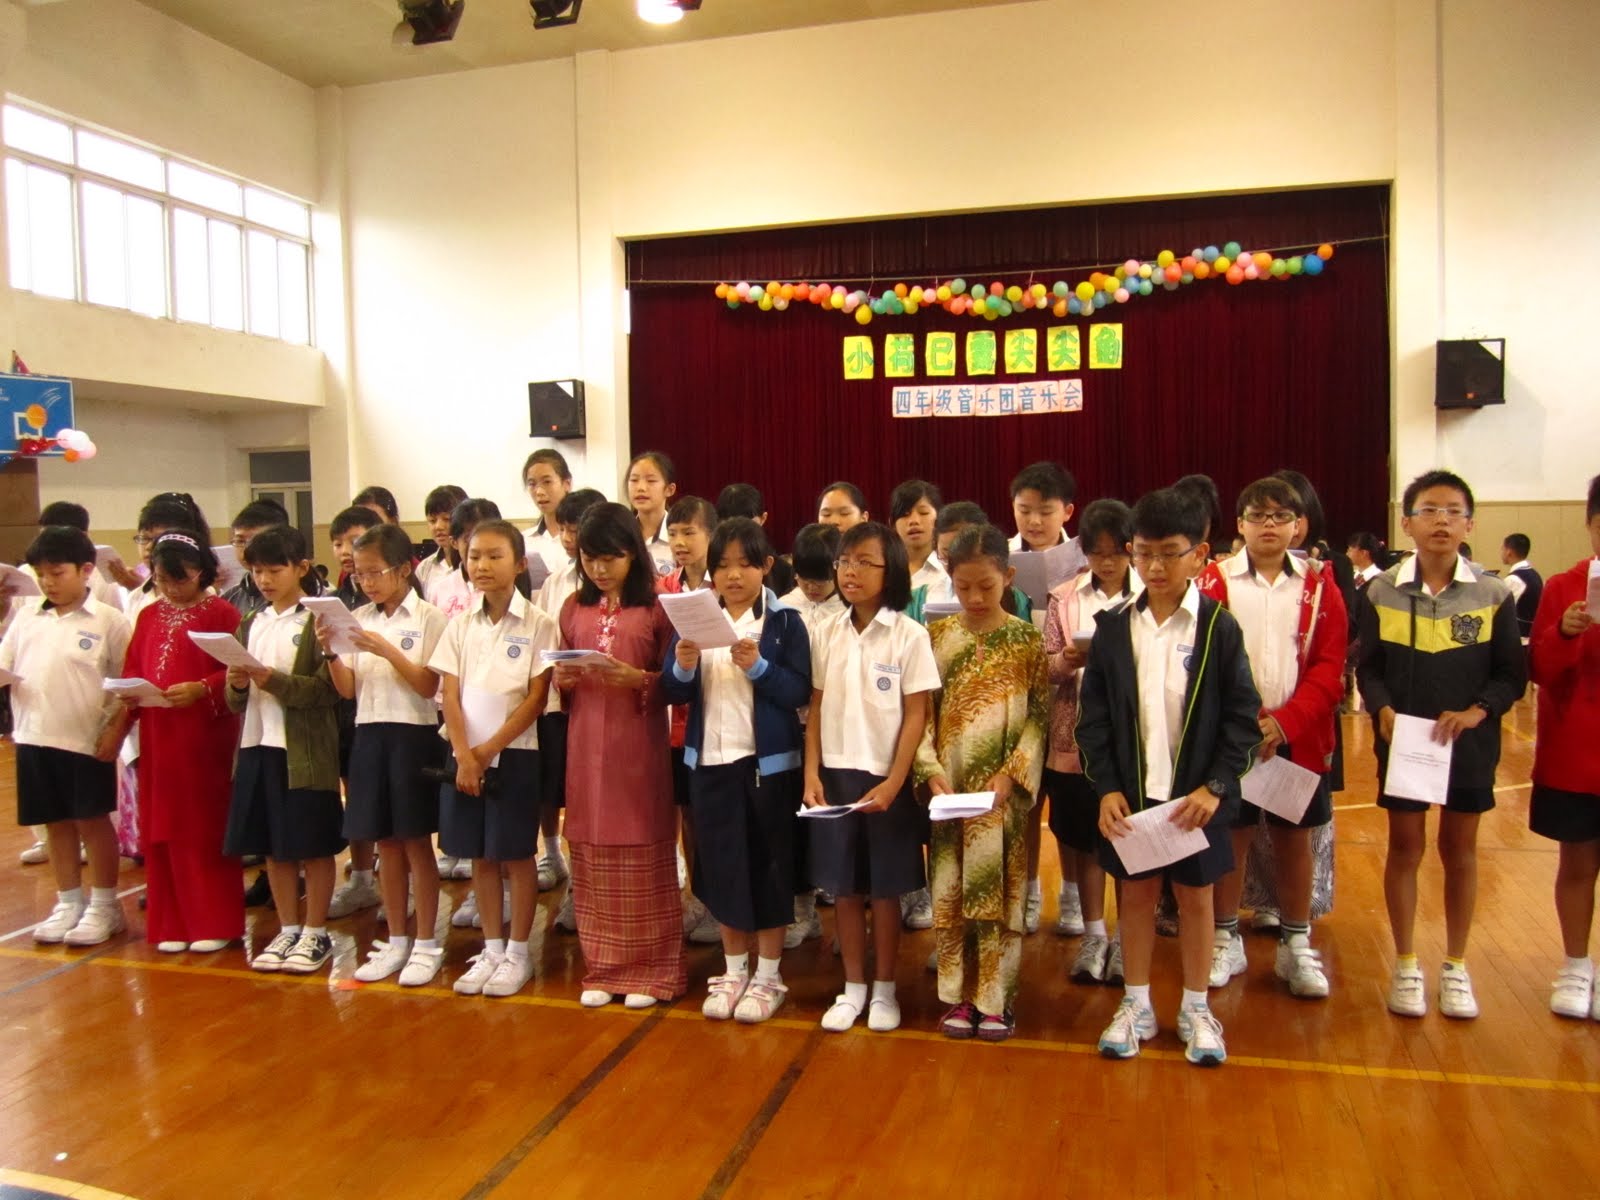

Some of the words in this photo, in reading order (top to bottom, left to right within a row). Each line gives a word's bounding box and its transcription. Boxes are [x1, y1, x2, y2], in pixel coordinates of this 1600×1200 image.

[895, 381, 1081, 415] 四年级管乐团音乐会
